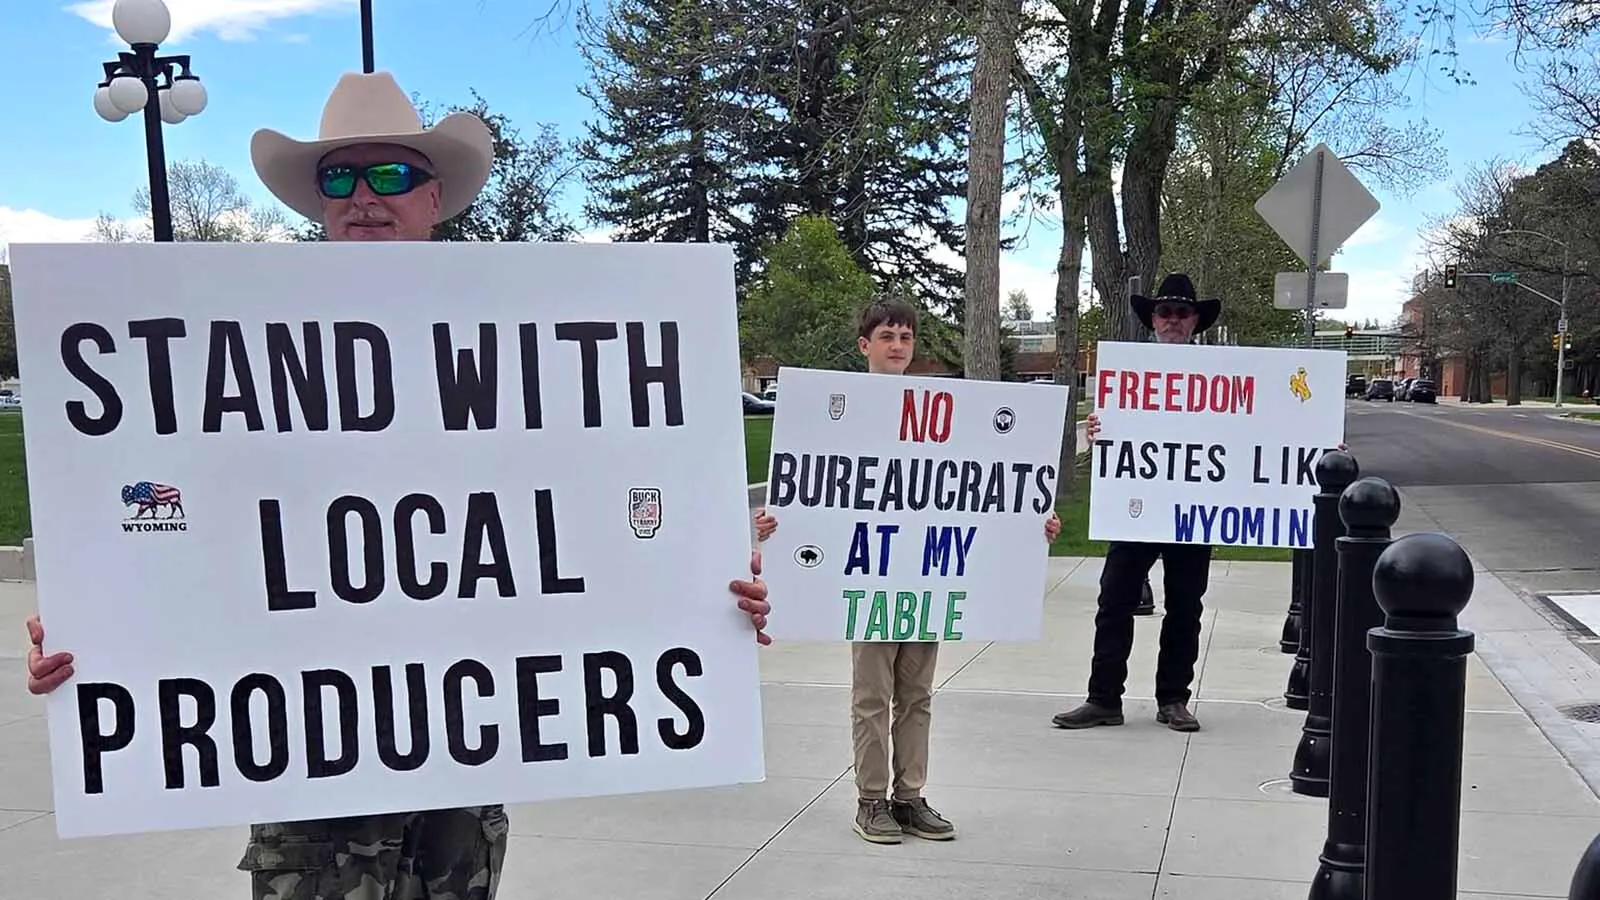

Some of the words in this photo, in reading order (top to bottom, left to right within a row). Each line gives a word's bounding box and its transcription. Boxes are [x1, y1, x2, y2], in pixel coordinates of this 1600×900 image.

[60, 318, 396, 436] STAND
[432, 321, 685, 431] WITH
[1098, 369, 1255, 415] FREEDOM
[899, 389, 954, 443] NO
[769, 452, 1056, 514] BUREAUCRATS
[1095, 439, 1226, 483] TASTES
[1253, 445, 1338, 486] LIK
[632, 491, 657, 503] BUCK
[121, 522, 187, 532] WYOMING
[258, 488, 586, 611] LOCAL
[843, 521, 900, 577] AT
[921, 525, 978, 577] MY
[1174, 503, 1316, 548] WYOMIN
[842, 589, 967, 641] TABLE
[76, 647, 705, 795] PRODUCERS
